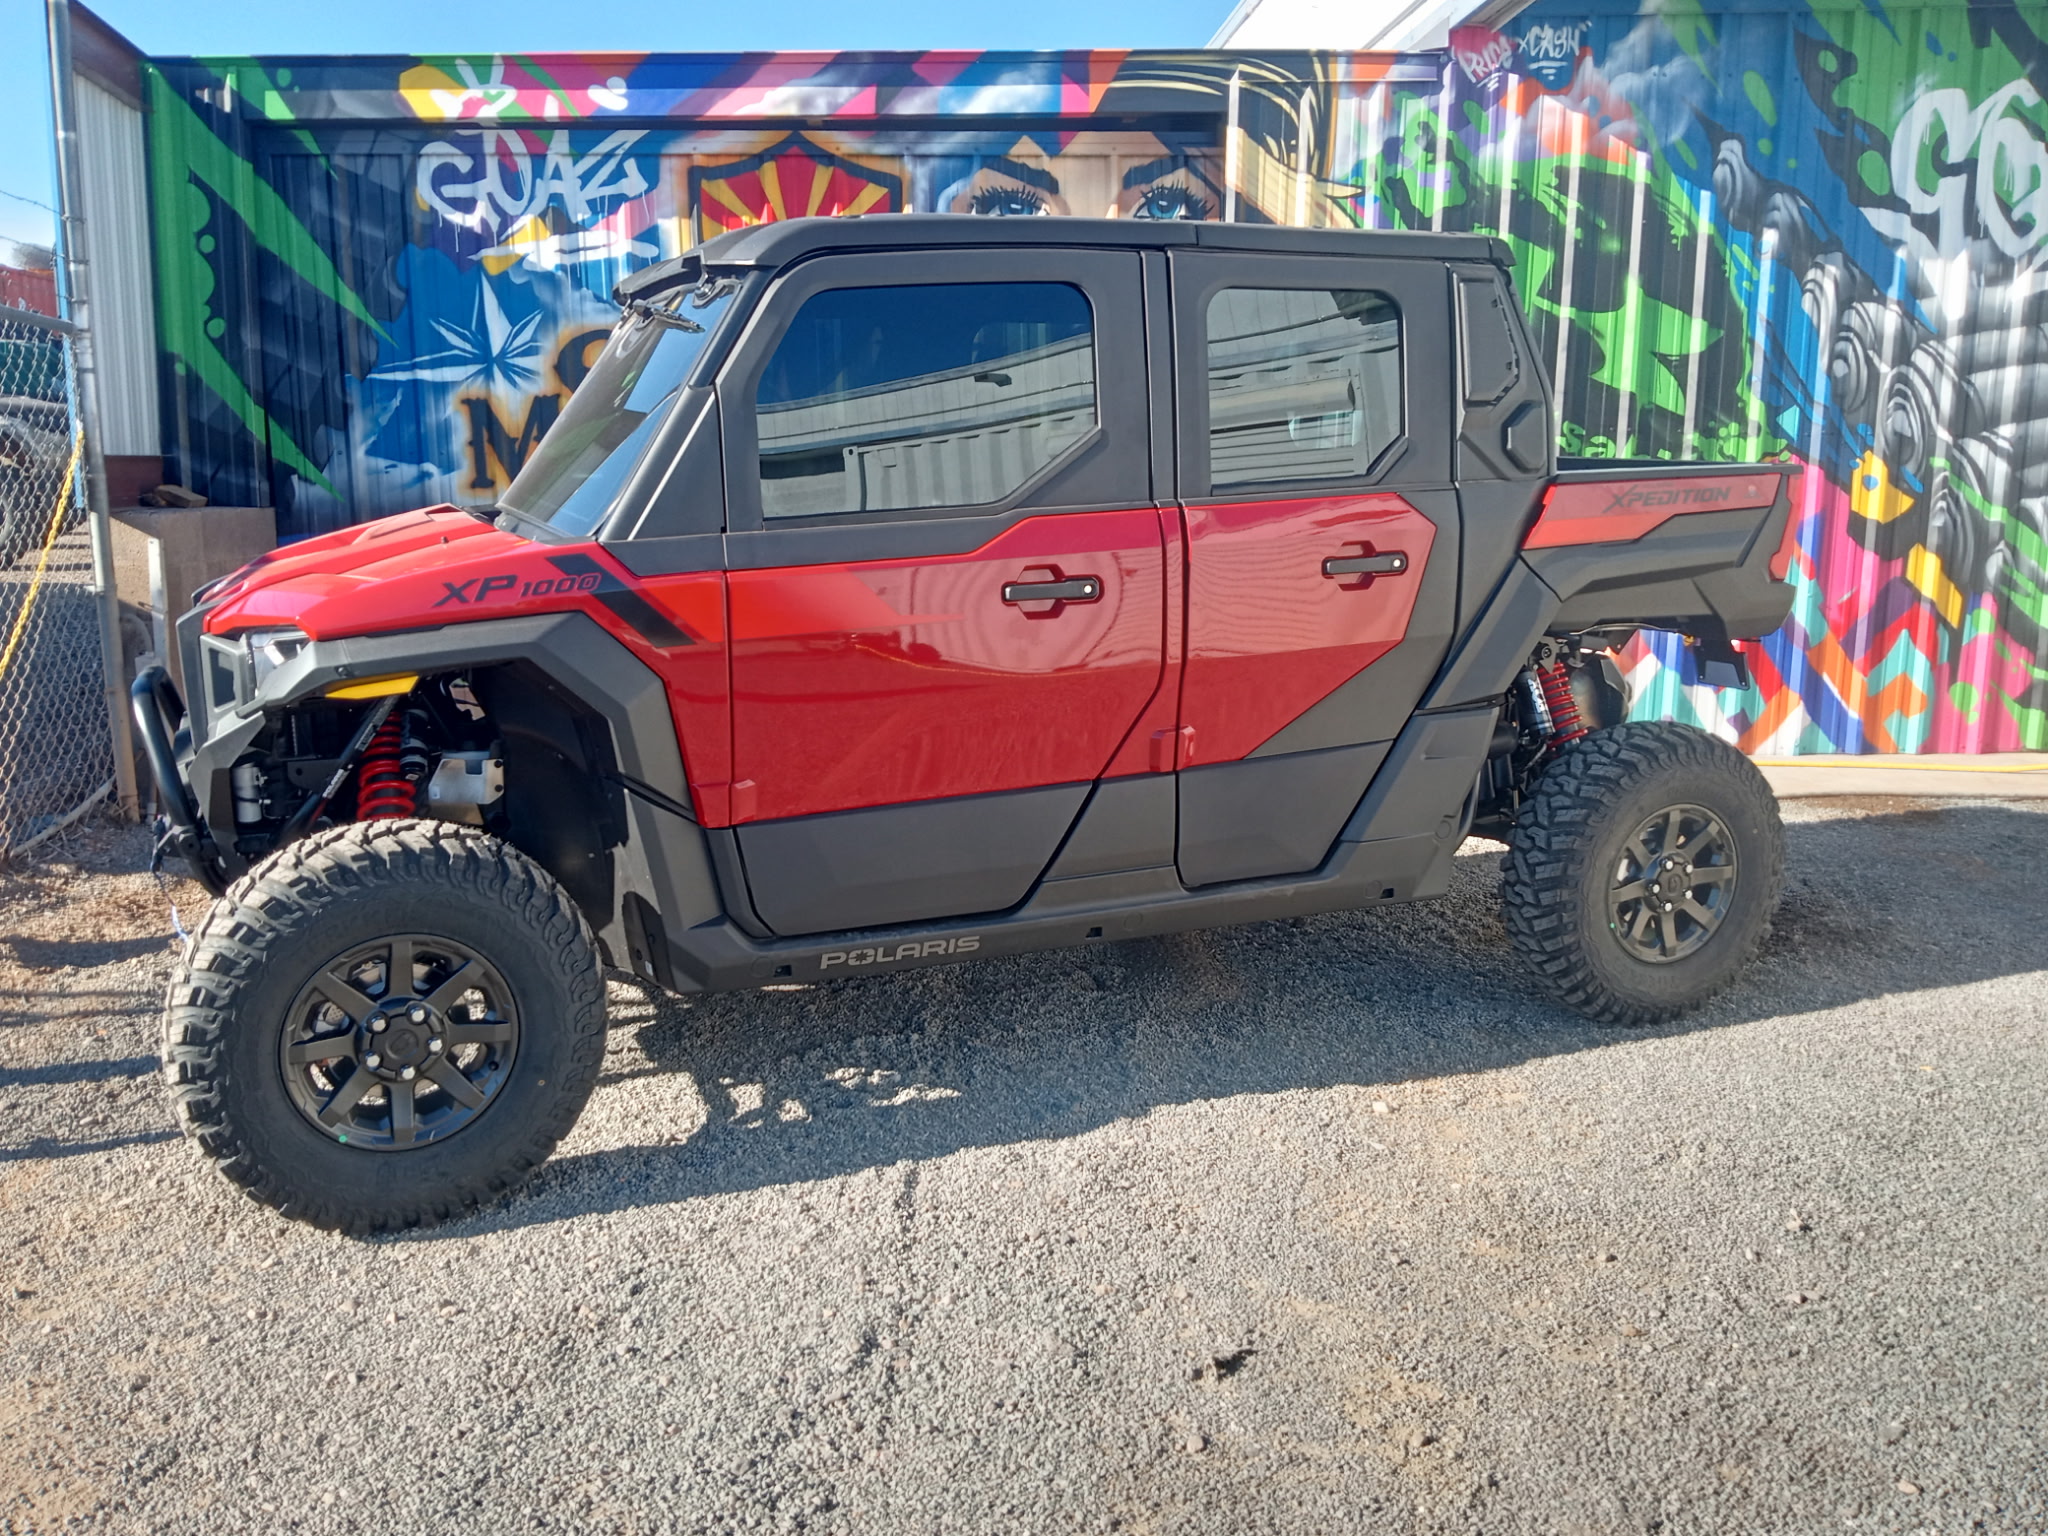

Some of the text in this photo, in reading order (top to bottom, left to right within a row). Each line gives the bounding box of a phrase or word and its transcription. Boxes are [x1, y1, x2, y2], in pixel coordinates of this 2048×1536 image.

[1602, 484, 1732, 514] XPEDITION
[431, 573, 602, 608] XP 1000
[819, 935, 981, 970] POLARIS
